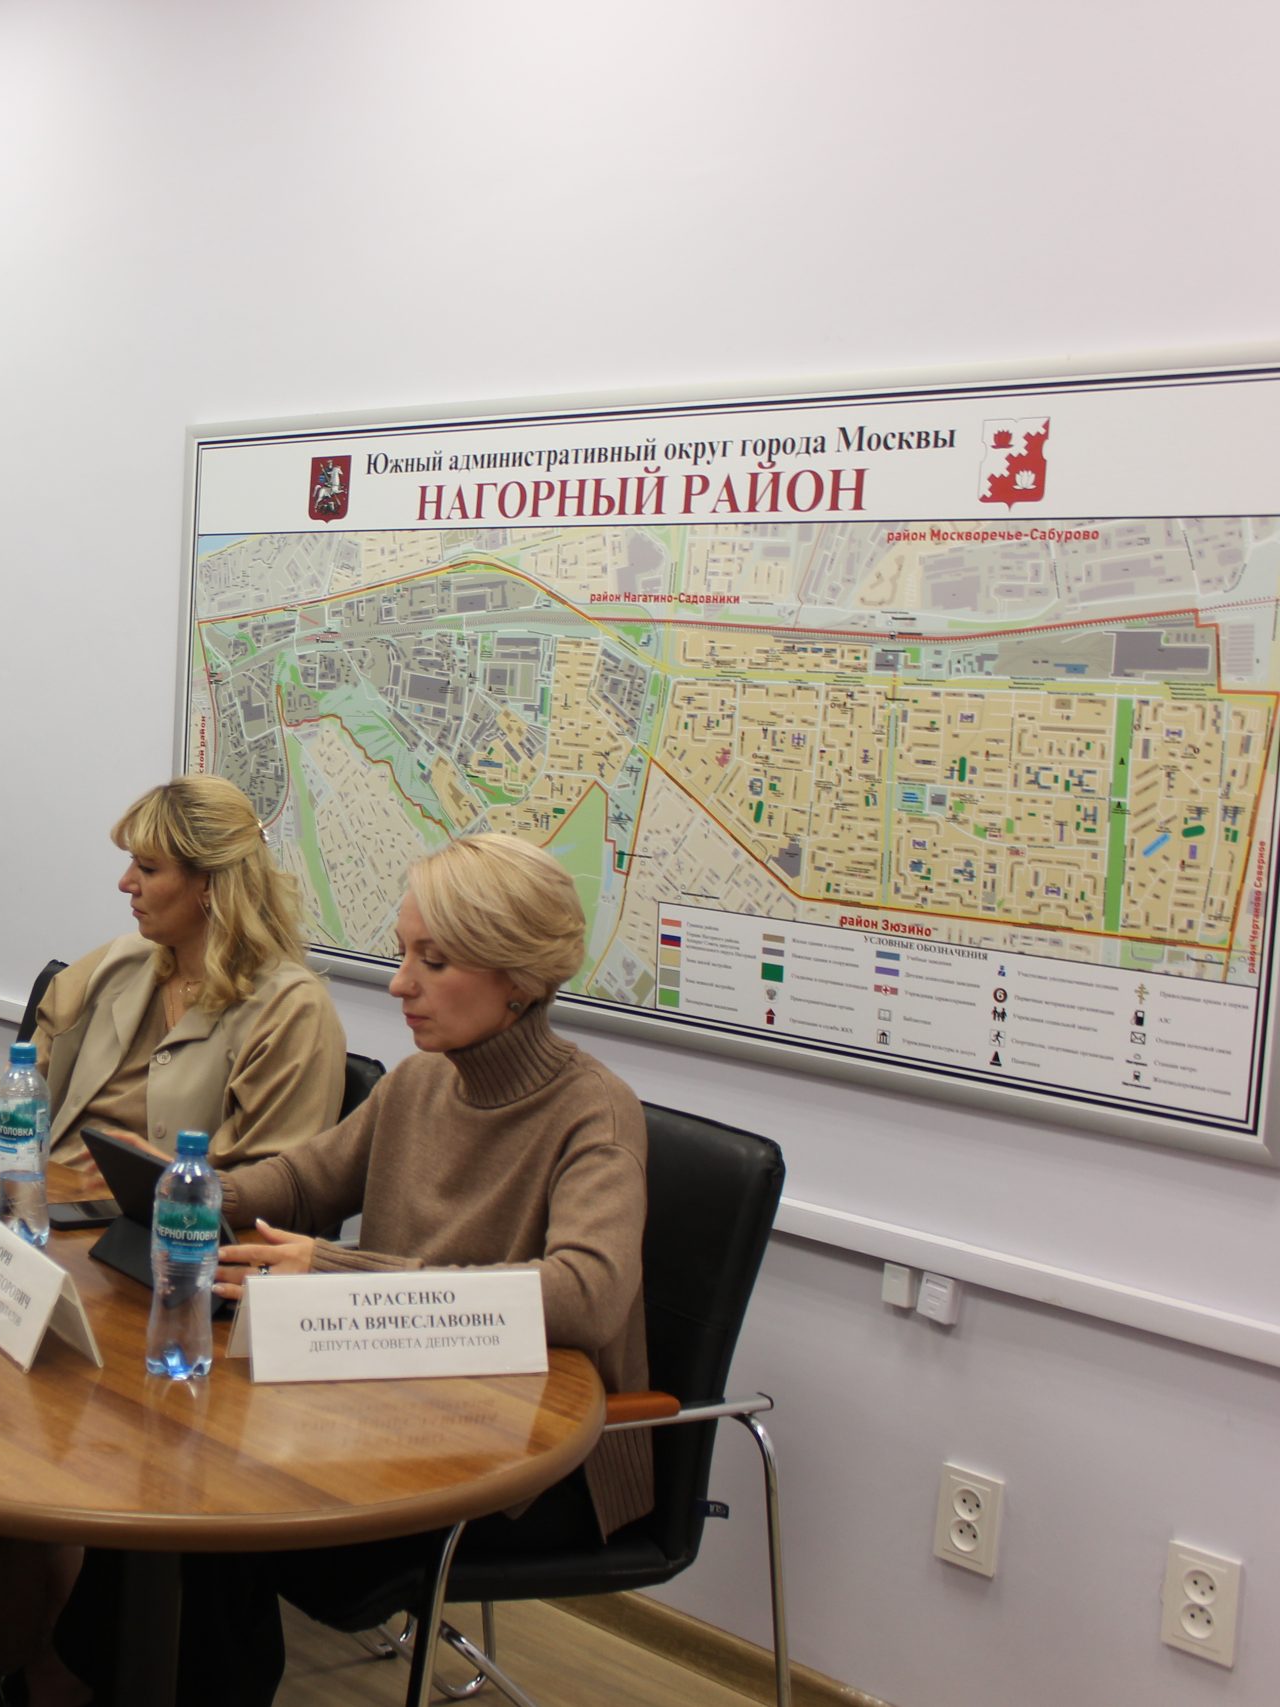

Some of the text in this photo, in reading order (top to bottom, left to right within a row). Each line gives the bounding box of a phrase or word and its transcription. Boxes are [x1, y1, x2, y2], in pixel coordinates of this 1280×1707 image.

[365, 425, 957, 475] Южный административный округ города Москвы
[415, 461, 870, 520] НАГОРНЫЙ РАЙОН
[887, 528, 1100, 543] район Москворечье-Сабурово
[590, 592, 740, 605] район Нагатино-Садовники
[839, 914, 932, 938] район Зюзино
[863, 935, 915, 951] УСЛОВНЫЕ
[916, 943, 989, 961] ОБОЗНАЧЕНИЯ
[349, 1290, 456, 1307] ТАРАСЕНКО
[300, 1312, 506, 1332] ОЛЬГА ВЯЧЕСЛАВОВНА
[309, 1335, 501, 1353] ДЕПУТАТ СОВЕТА ДЕПУТАТОВ
